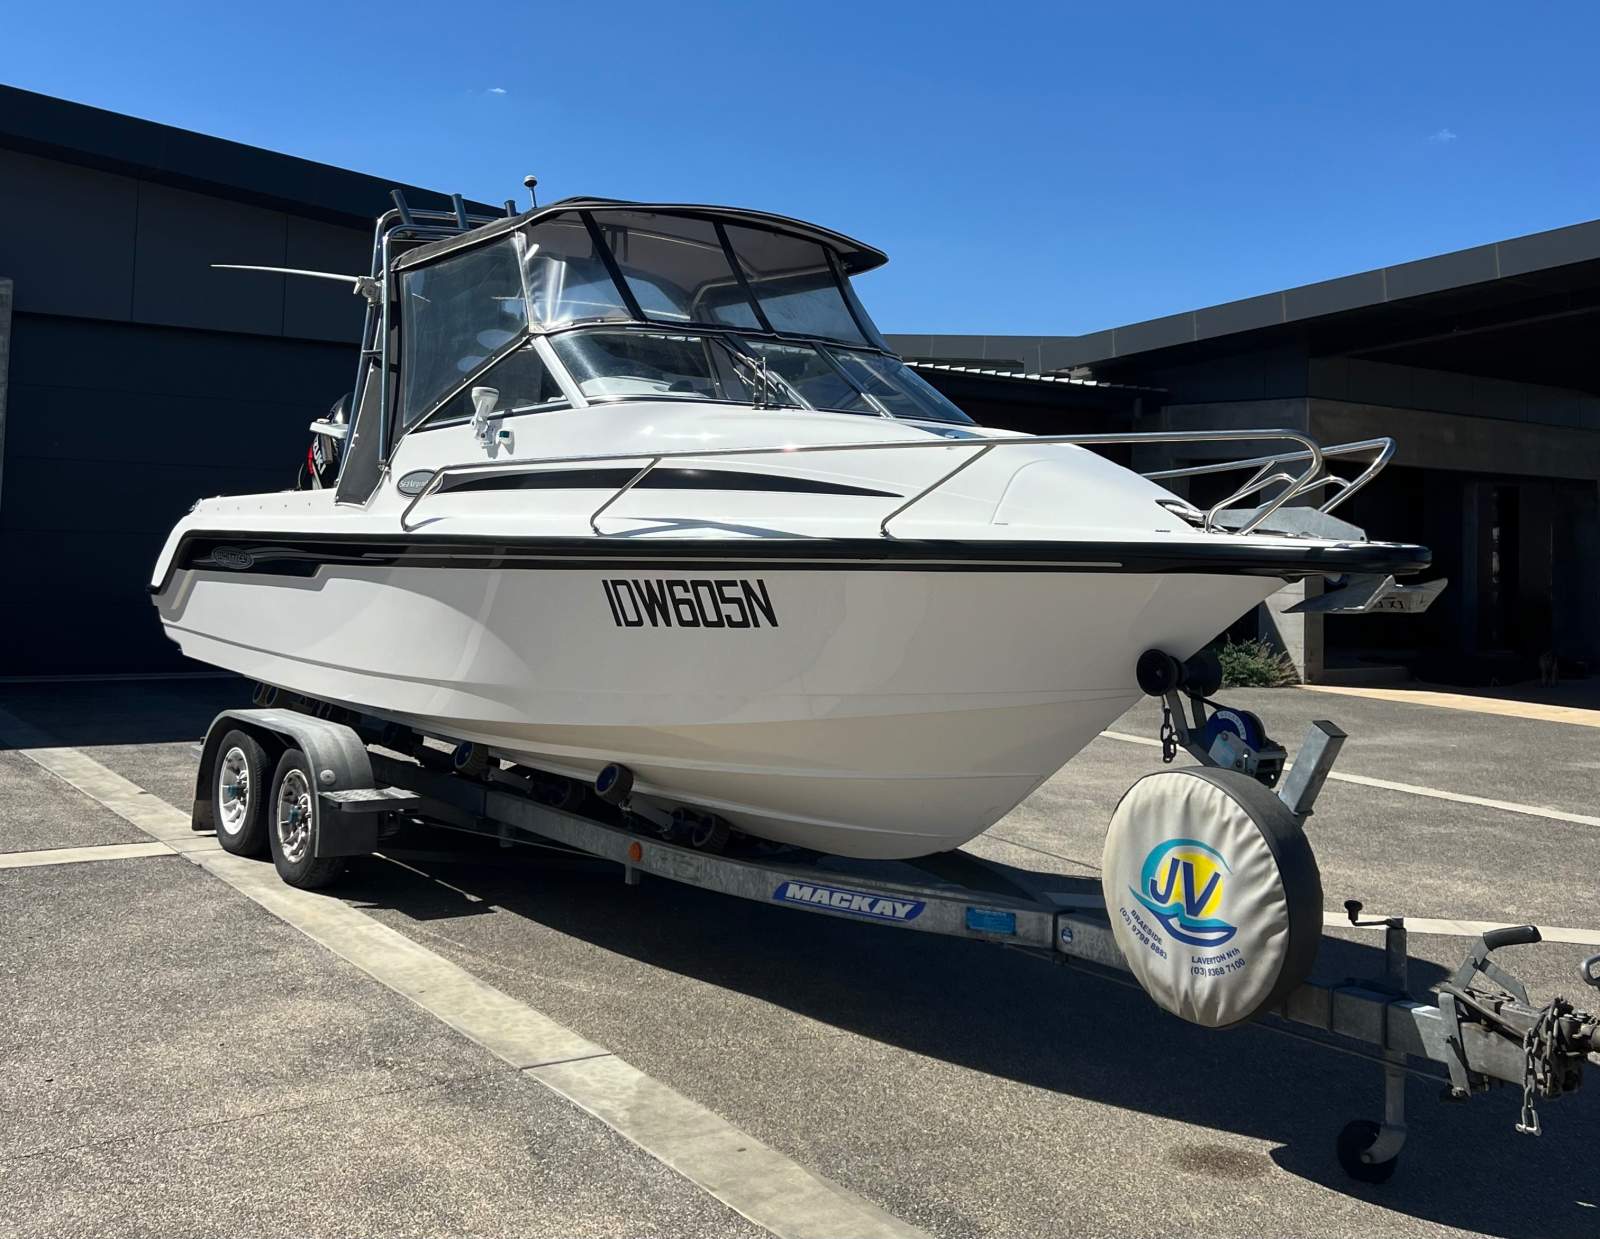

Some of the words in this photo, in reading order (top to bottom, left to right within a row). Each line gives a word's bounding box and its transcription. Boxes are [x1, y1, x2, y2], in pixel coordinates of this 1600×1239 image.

[785, 884, 915, 919] MACKAY
[1150, 857, 1222, 917] JV
[1119, 907, 1132, 926] (03)
[1132, 924, 1149, 945] 9798
[1131, 909, 1162, 945] BRAESIDE
[1190, 966, 1208, 978] (03)
[1226, 957, 1246, 974] 7100
[1191, 953, 1227, 965] LAVERTON
[1227, 947, 1241, 959] Nth
